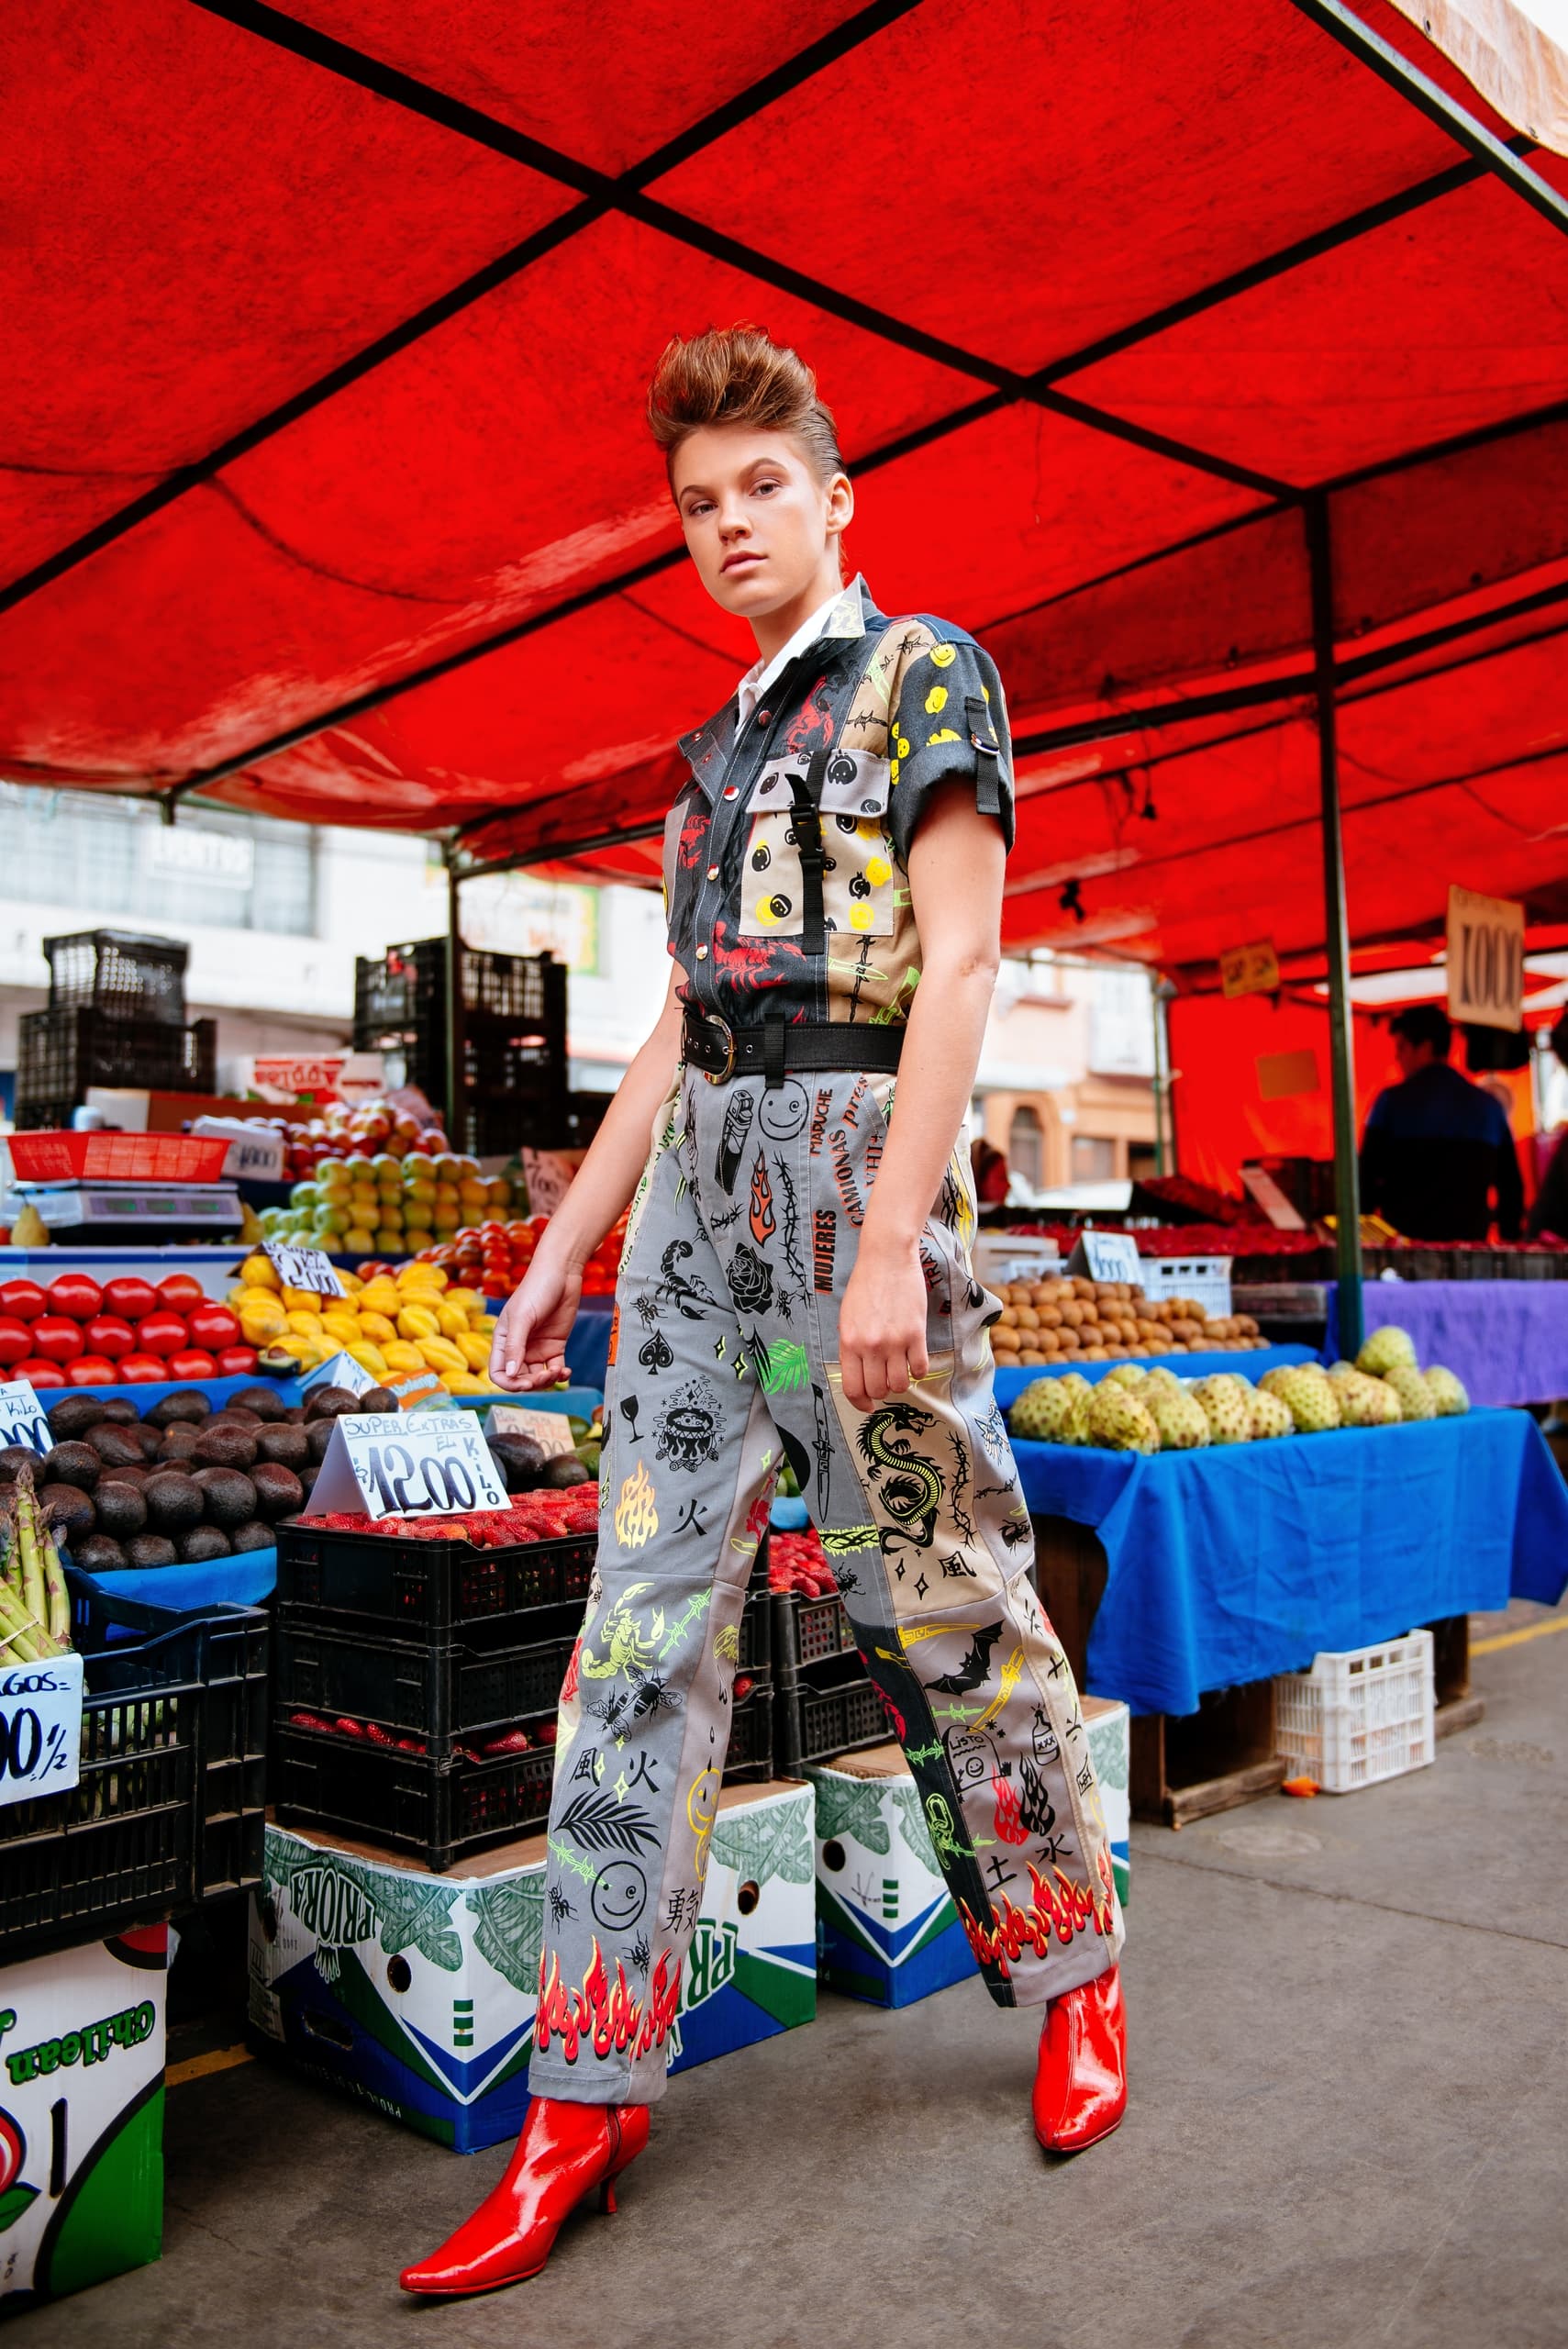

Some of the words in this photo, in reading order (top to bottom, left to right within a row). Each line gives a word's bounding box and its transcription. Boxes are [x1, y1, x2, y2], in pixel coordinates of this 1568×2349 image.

[810, 1088, 833, 1157] MAPUCHE
[828, 1129, 865, 1228] CAMIONAS
[811, 1209, 837, 1295] MUJERES
[345, 1416, 402, 1435] SUPER
[435, 1436, 457, 1452] EL
[671, 1498, 707, 1536] 火
[628, 1750, 660, 1793] 火
[1035, 1834, 1073, 1865] 水
[289, 1865, 377, 1946] PRIORA
[6, 2000, 156, 2086] Chilean
